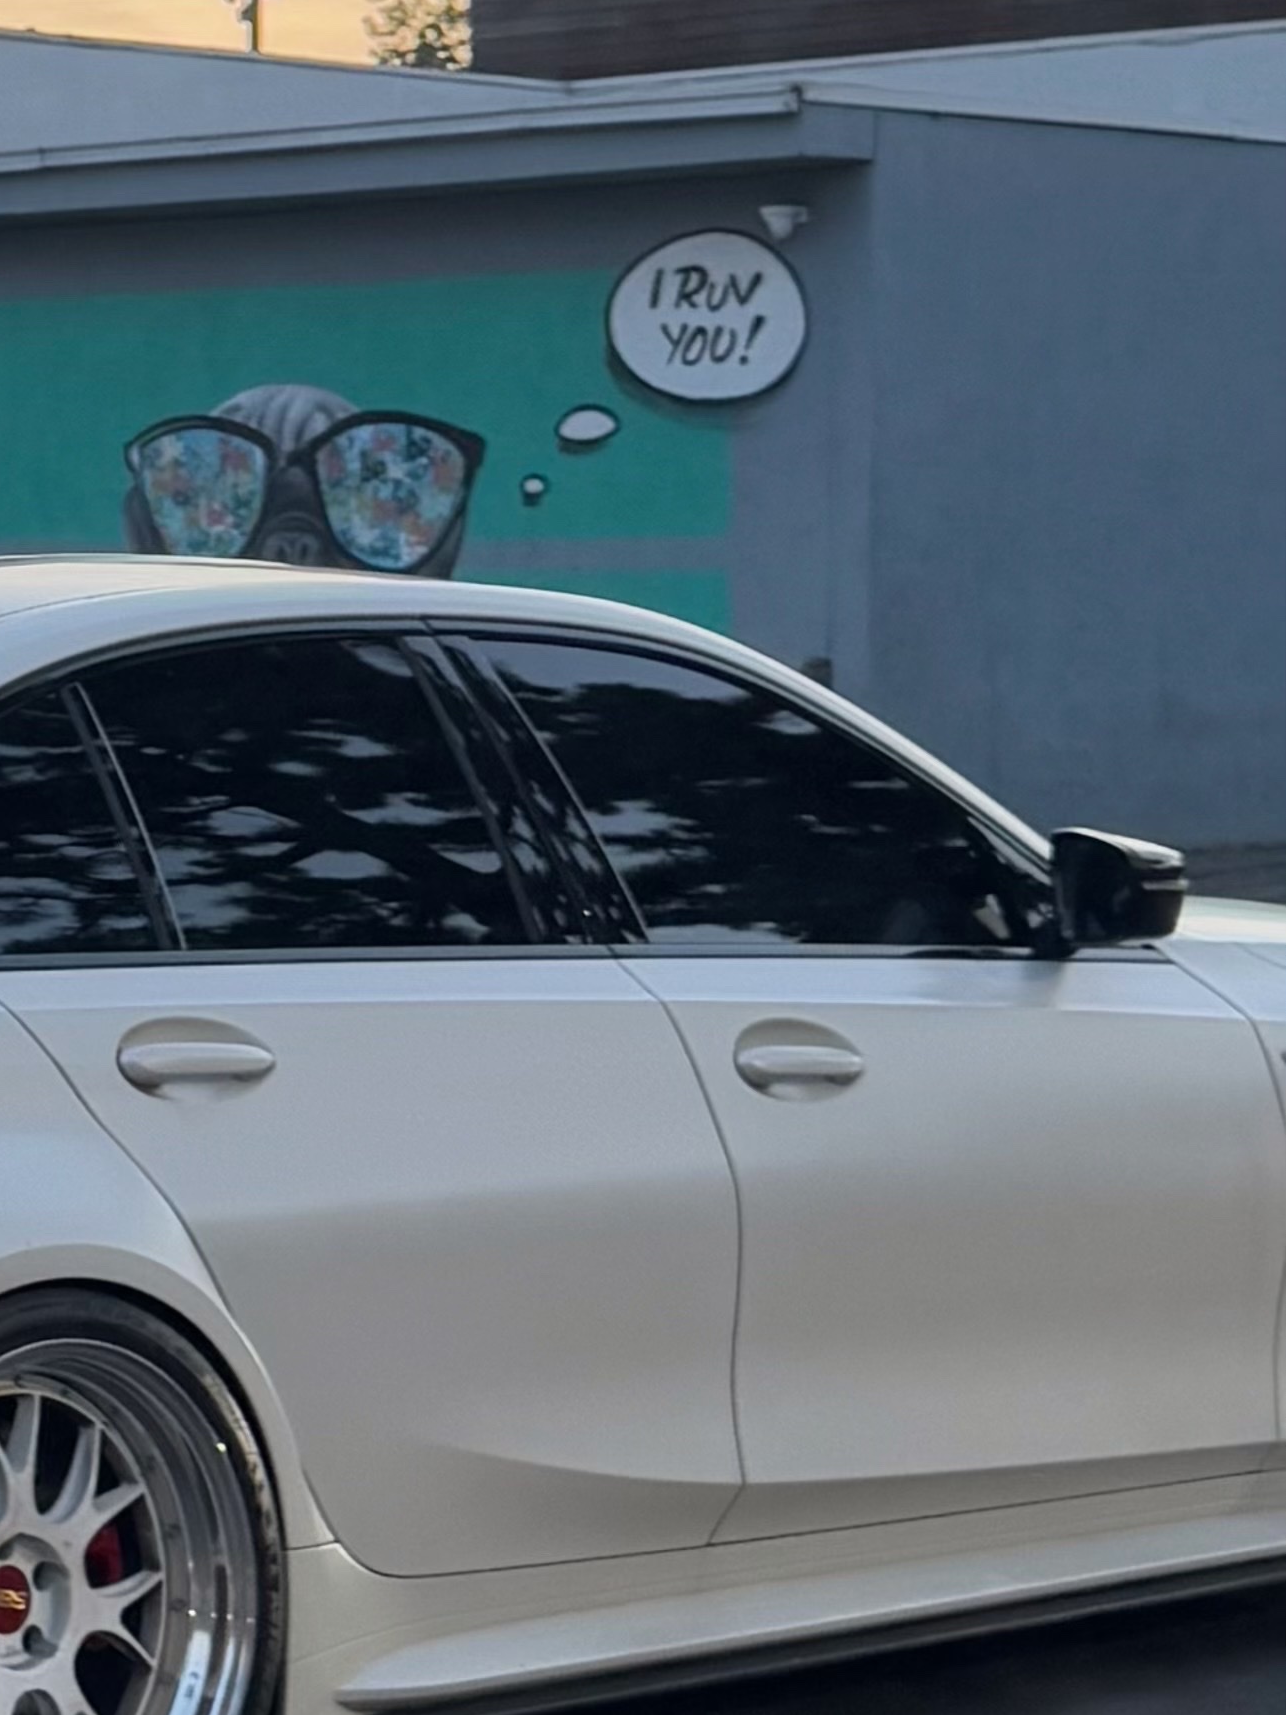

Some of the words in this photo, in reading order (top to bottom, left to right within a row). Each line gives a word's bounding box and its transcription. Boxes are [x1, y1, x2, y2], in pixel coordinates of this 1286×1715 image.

[648, 267, 665, 310] I
[673, 263, 764, 313] RUV
[659, 314, 767, 367] YOU!
